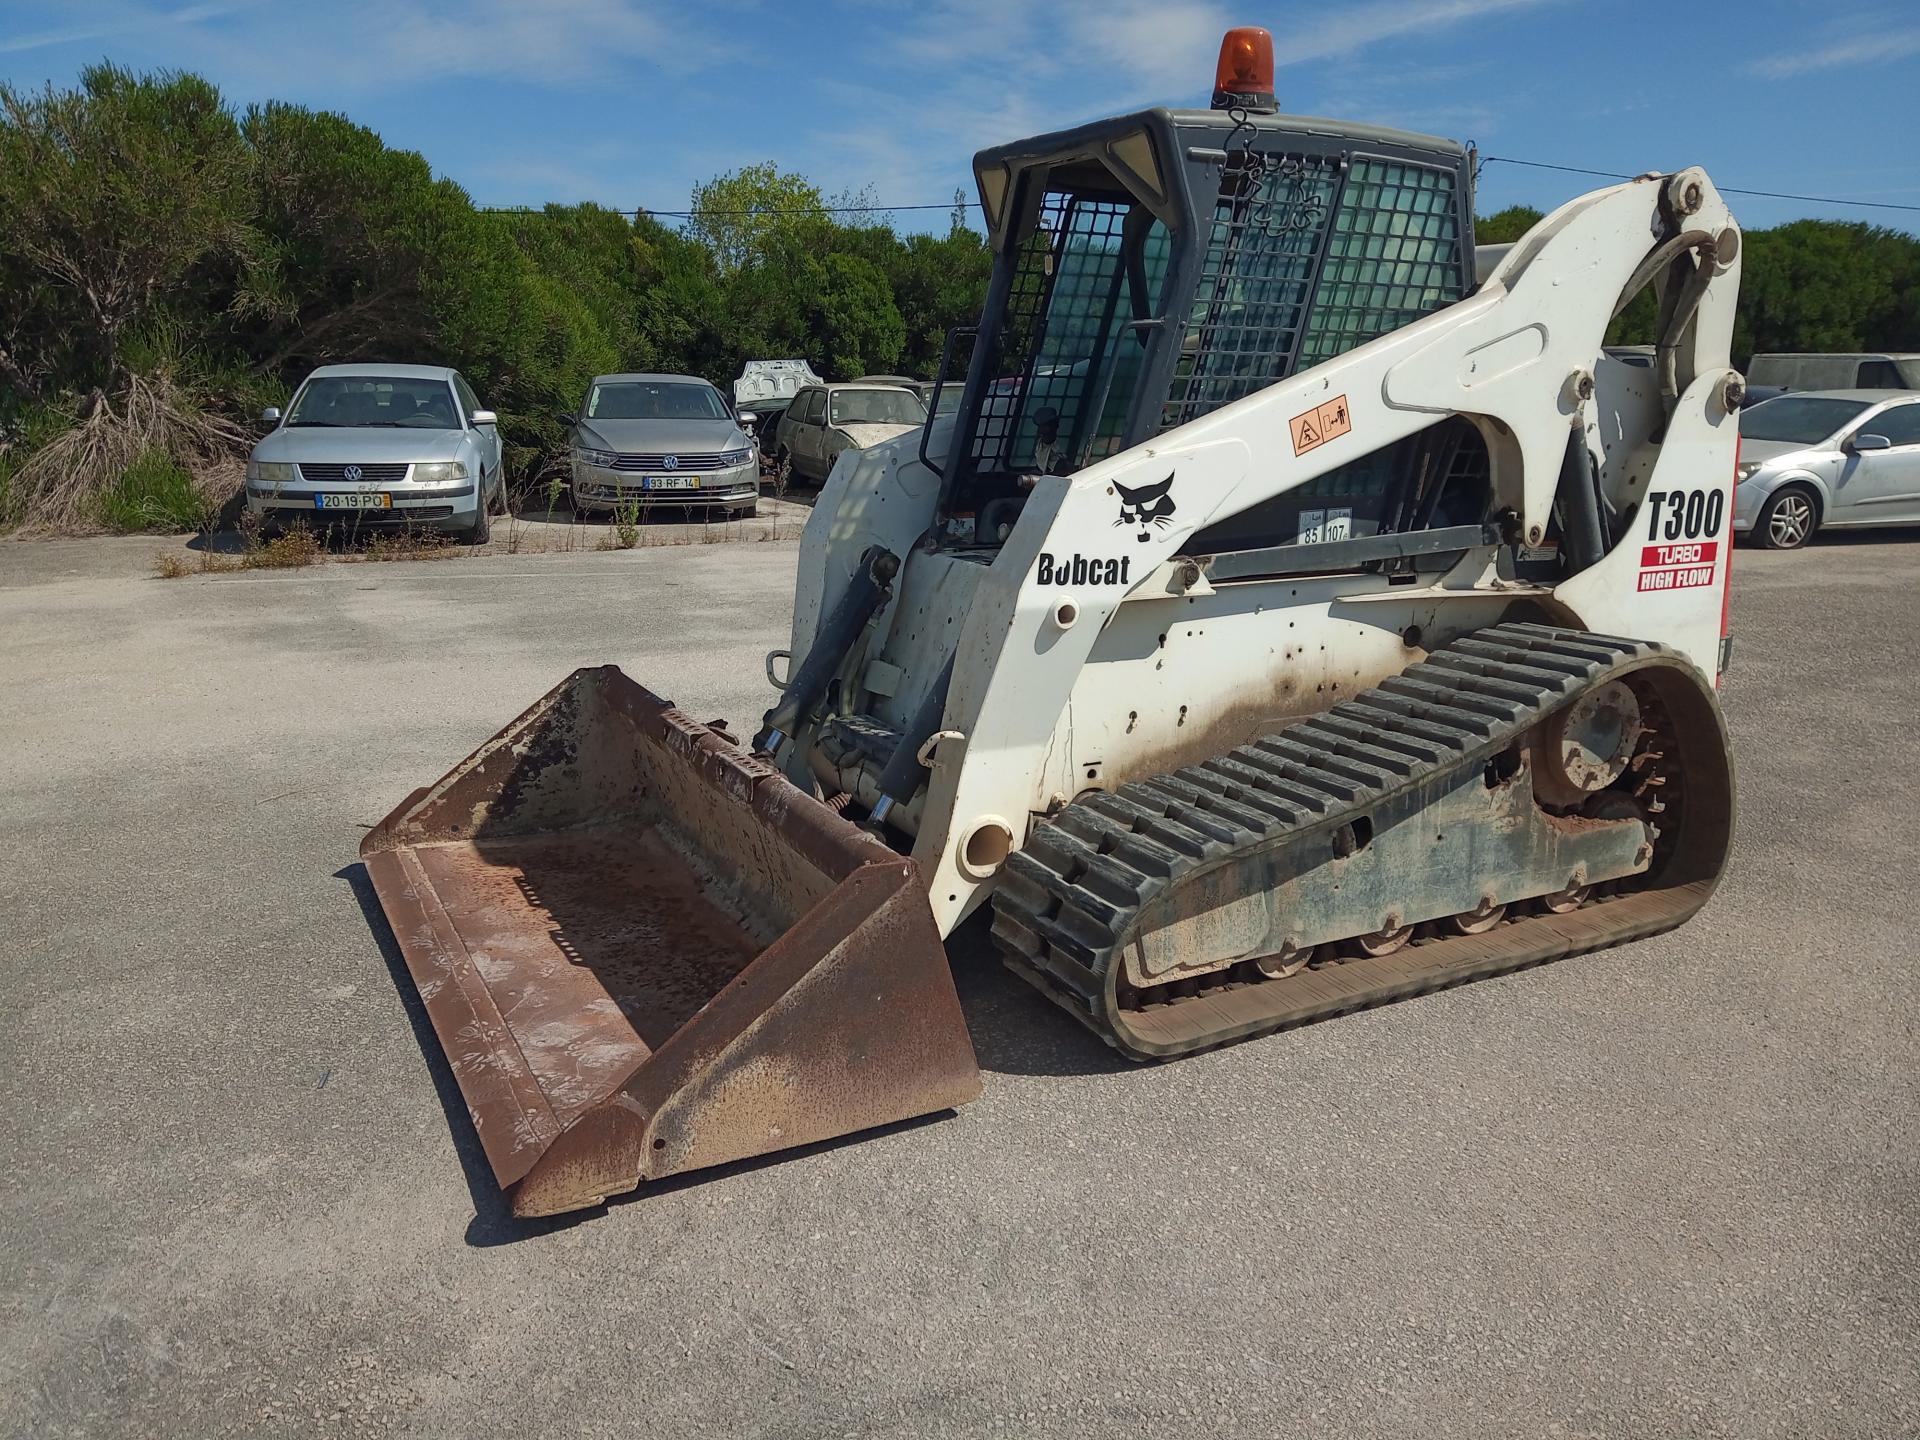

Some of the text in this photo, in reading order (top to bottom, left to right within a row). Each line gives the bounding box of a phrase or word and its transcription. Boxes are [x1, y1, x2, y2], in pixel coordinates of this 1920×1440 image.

[1648, 488, 1724, 541] T300
[1305, 527, 1318, 544] 85
[1328, 525, 1345, 542] 107
[1657, 545, 1702, 564] TURBO
[1037, 552, 1130, 585] Bobcat
[1640, 568, 1711, 590] HIGH FLOW
